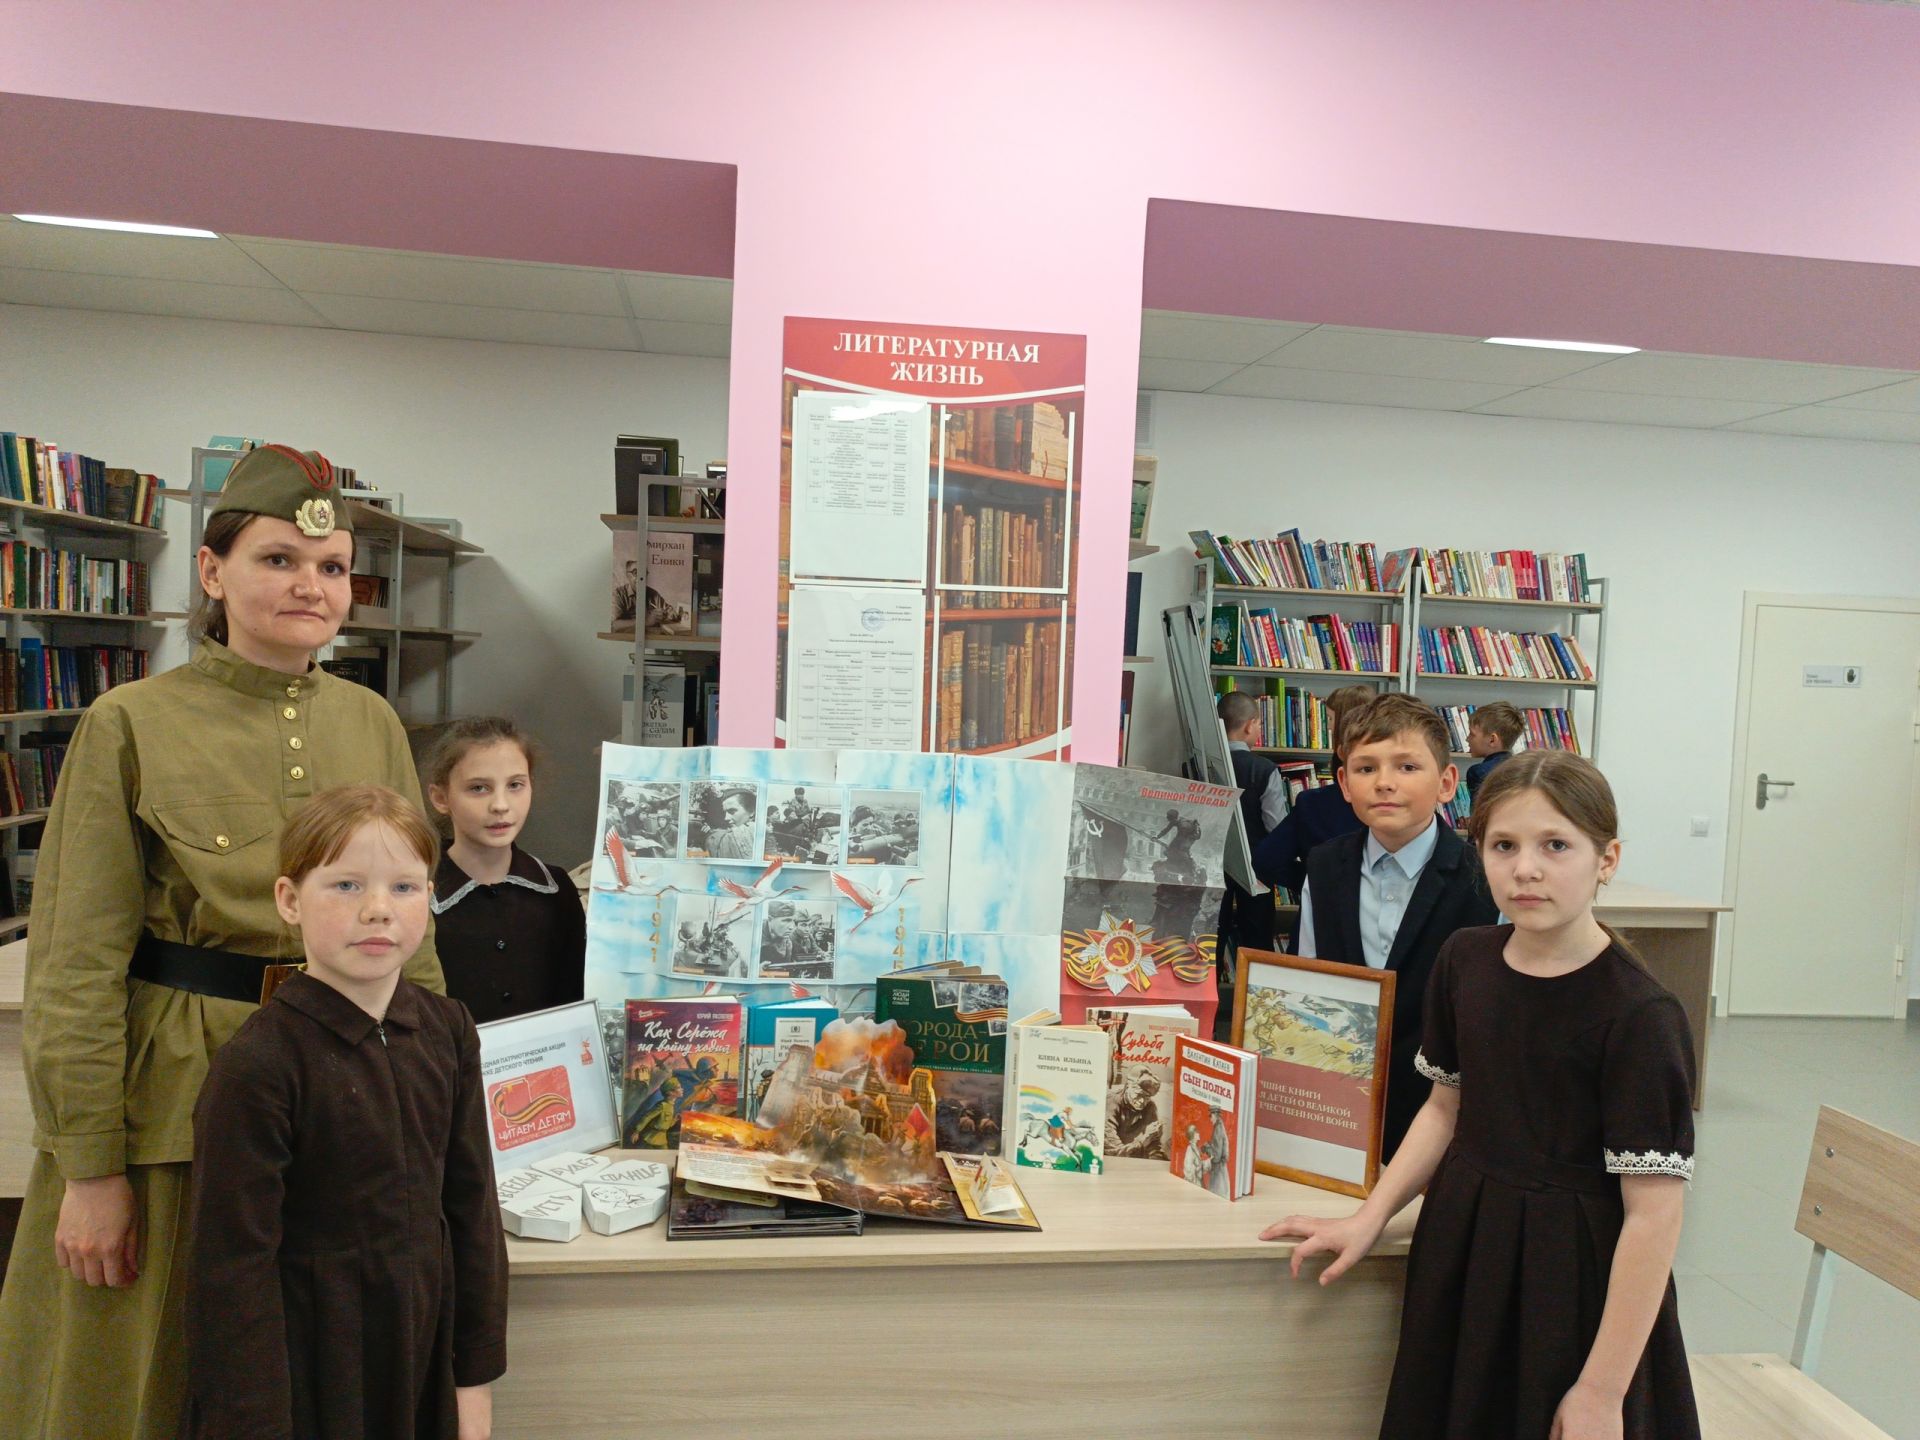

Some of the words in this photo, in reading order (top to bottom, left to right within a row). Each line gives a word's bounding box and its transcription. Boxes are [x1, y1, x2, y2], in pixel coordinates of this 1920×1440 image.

[833, 332, 1040, 364] ЛИТЕРАТУРНАЯ
[891, 362, 984, 386] ЖИЗНЬ
[647, 540, 685, 551] мирхан
[652, 554, 685, 566] Еники
[1188, 782, 1208, 793] 80
[644, 1021, 672, 1039] Как
[637, 1042, 654, 1053] на
[656, 1039, 692, 1056] войну
[1121, 1030, 1165, 1051] Судьба
[495, 1061, 522, 1075] ДЕТСКОГО
[1183, 1072, 1201, 1088] СЫН
[1202, 1079, 1232, 1100] ПОЛКА
[1288, 1086, 1320, 1100] КНИГИ
[1267, 1093, 1297, 1106] ДЕТЕЙ
[1306, 1102, 1351, 1118] ВЕЛИКОЙ
[498, 1122, 536, 1141] ЧИТАЕМ
[537, 1110, 571, 1130] ДЕТЯМ
[1325, 1116, 1360, 1130] ВОЙНЕ
[551, 1156, 600, 1177] БУДЕТ
[600, 1163, 662, 1182] СОЛНЦЕ
[499, 1169, 544, 1199] ВСЕГДА
[521, 1194, 575, 1217] ПУСТЬ
